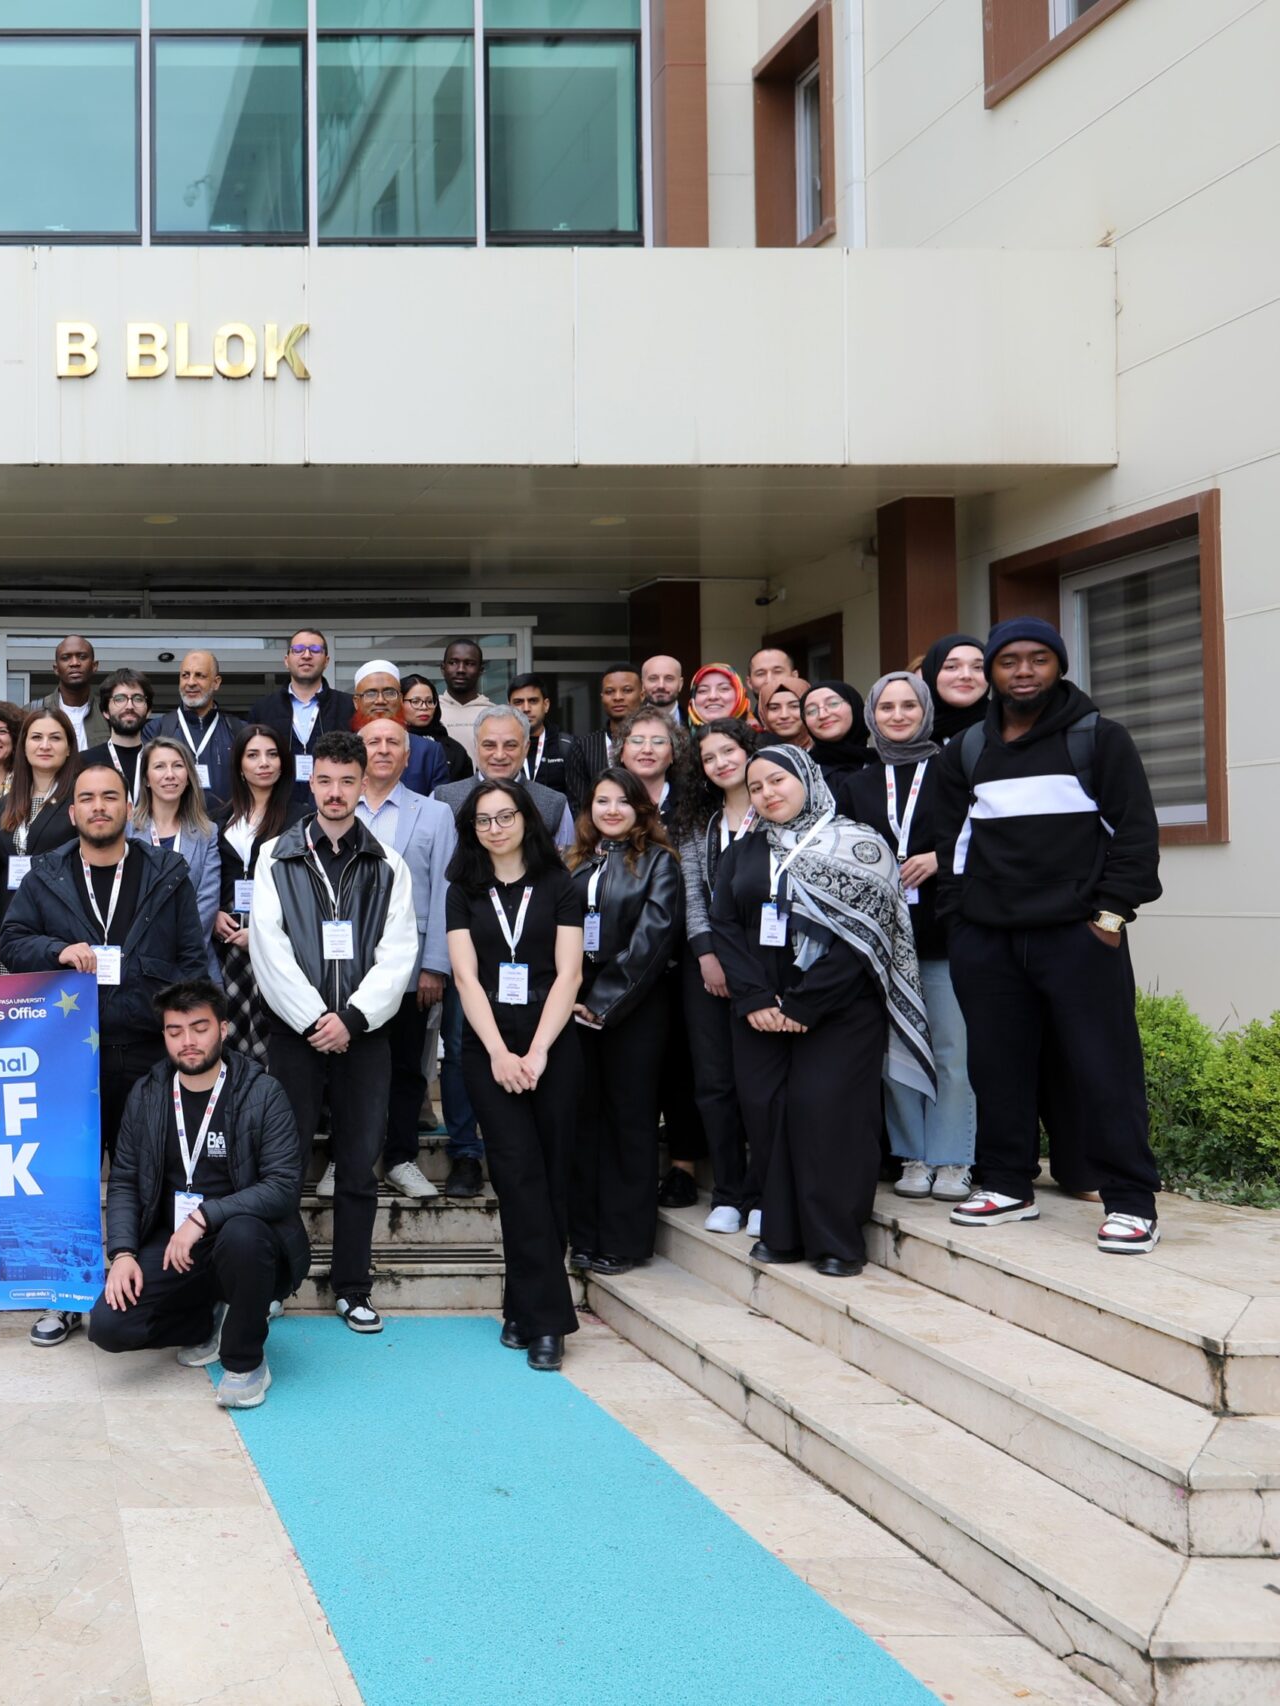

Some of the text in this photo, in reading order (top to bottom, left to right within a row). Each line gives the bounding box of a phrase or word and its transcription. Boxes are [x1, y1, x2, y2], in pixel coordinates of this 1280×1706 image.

[55, 321, 311, 380] B BLOK
[14, 996, 46, 1004] UNIVERSITY
[8, 1007, 47, 1020] Office
